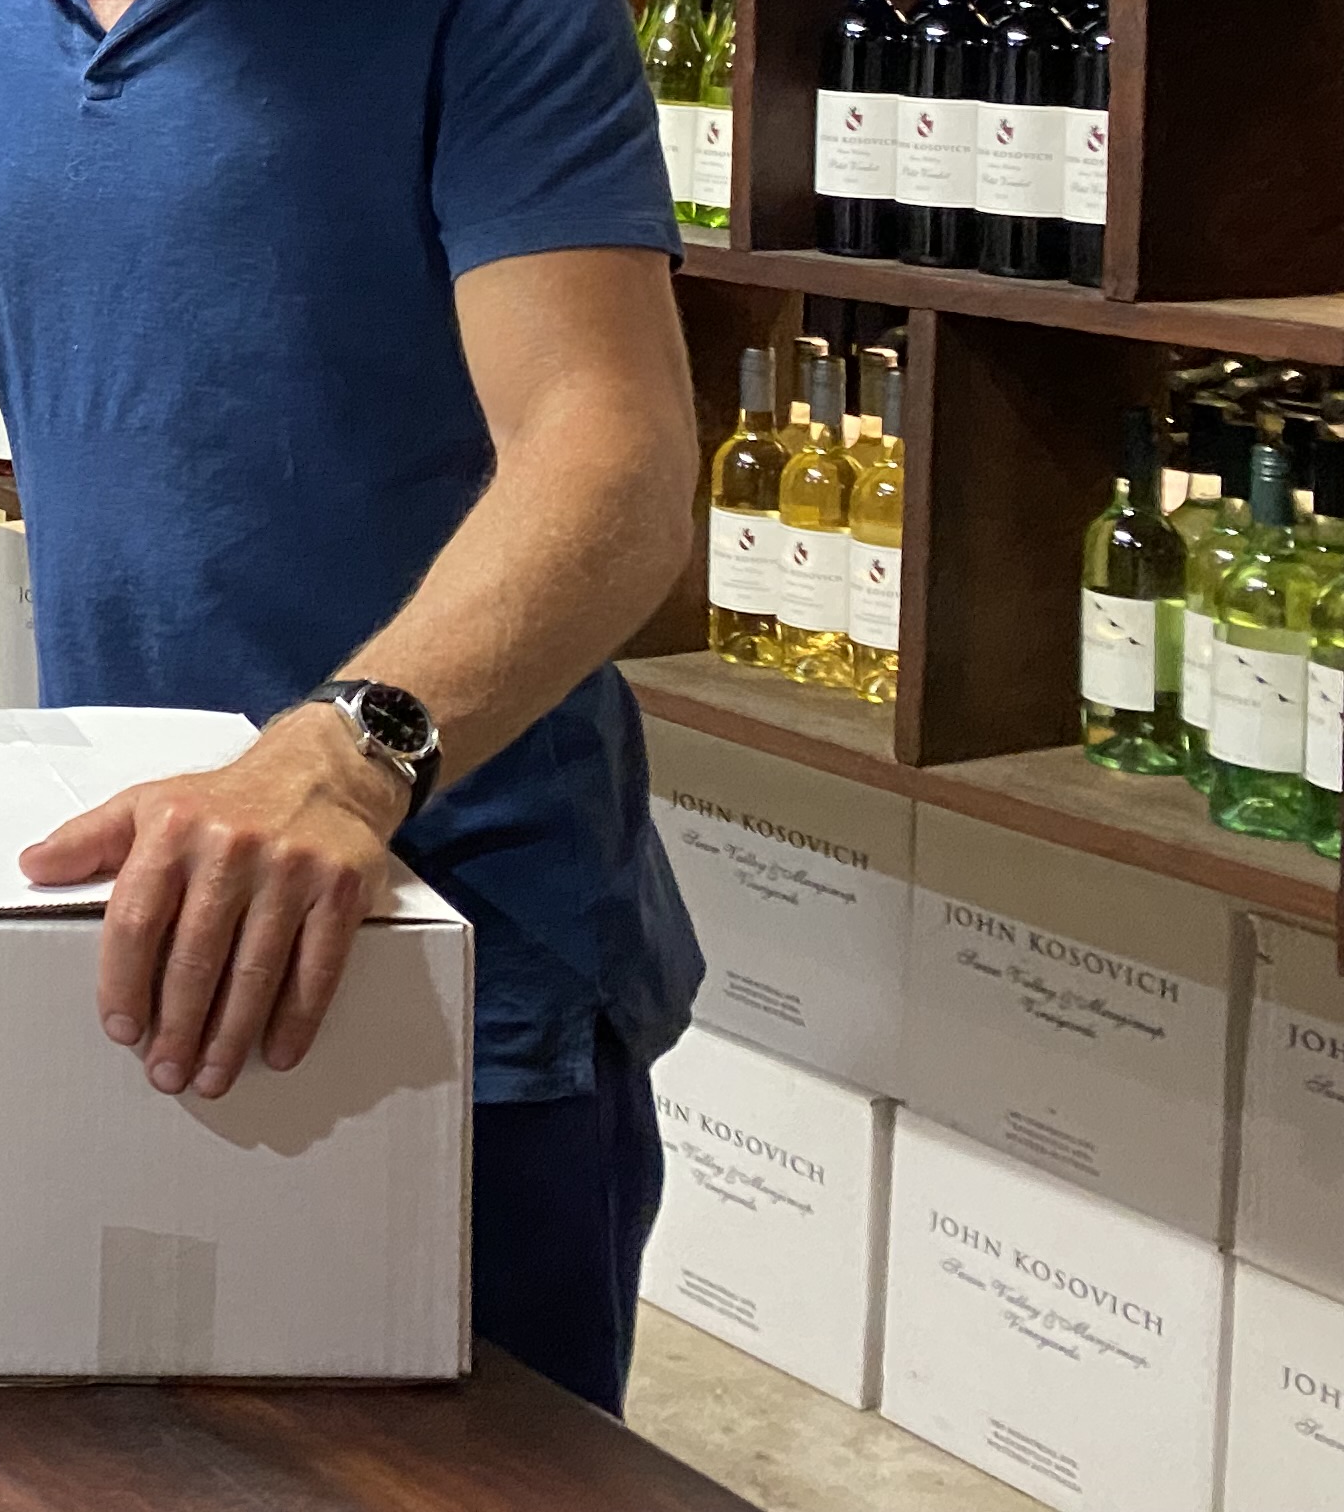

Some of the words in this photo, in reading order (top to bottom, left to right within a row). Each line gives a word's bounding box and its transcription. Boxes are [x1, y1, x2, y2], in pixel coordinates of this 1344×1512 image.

[672, 789, 731, 823] JOHN
[742, 814, 870, 871] KOSOVICH
[943, 901, 1016, 946] JOHN
[1029, 932, 1180, 1004] KOSOVICH
[656, 1093, 690, 1124] HN
[699, 1111, 825, 1187] KOSOVICH
[928, 1207, 1002, 1259] JOHN
[1012, 1247, 1163, 1337] KOSOVICH
[1280, 1364, 1344, 1411] JOH
